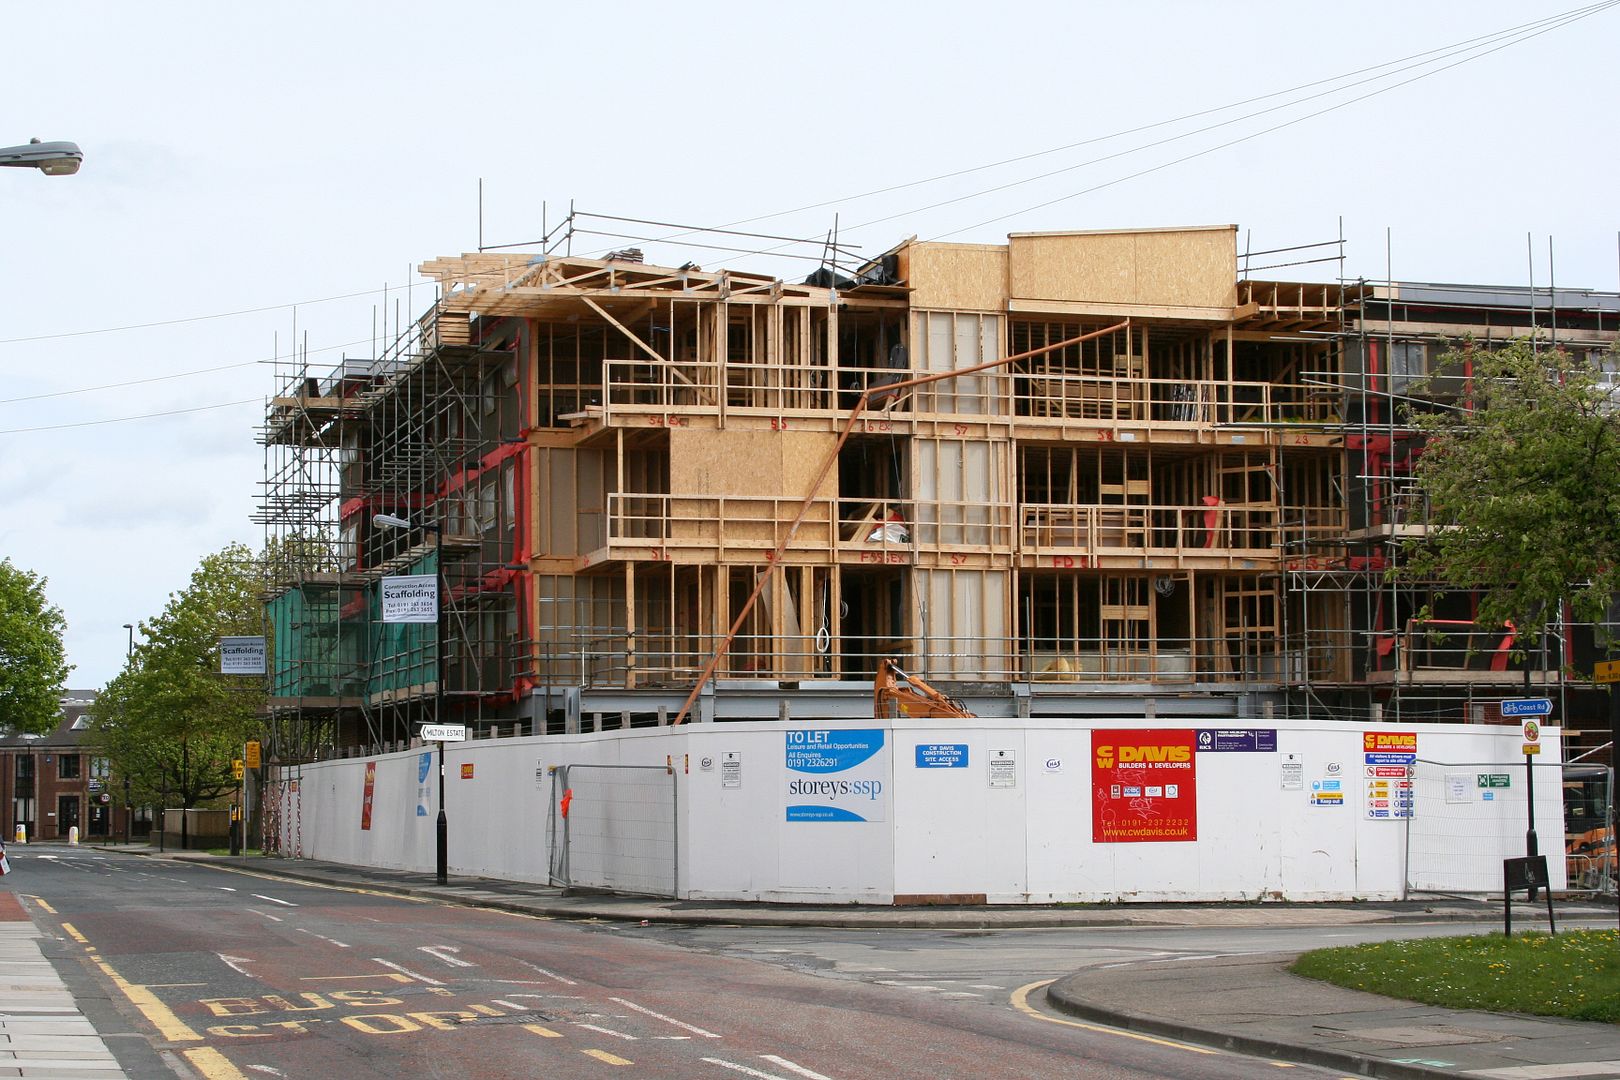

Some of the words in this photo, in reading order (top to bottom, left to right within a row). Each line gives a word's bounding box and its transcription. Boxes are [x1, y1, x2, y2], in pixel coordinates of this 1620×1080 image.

[954, 424, 968, 435] 57
[1097, 428, 1113, 440] 58
[1296, 434, 1308, 444] 23
[951, 552, 968, 564] 57
[384, 590, 436, 600] Scaffolding
[222, 647, 264, 655] Scaffolding
[427, 729, 445, 737] MILTON
[788, 731, 804, 743] TO
[808, 731, 830, 743] LET
[1378, 736, 1416, 745] DAVIS
[1119, 746, 1190, 762] DAVIS
[788, 759, 805, 768] 0191
[807, 758, 838, 767] 2326291
[790, 779, 882, 800] storeys:ssp
[1104, 827, 1188, 836] www.cwdavis.co.uk
[200, 990, 404, 1016] BUS
[206, 1012, 478, 1037] STOP
